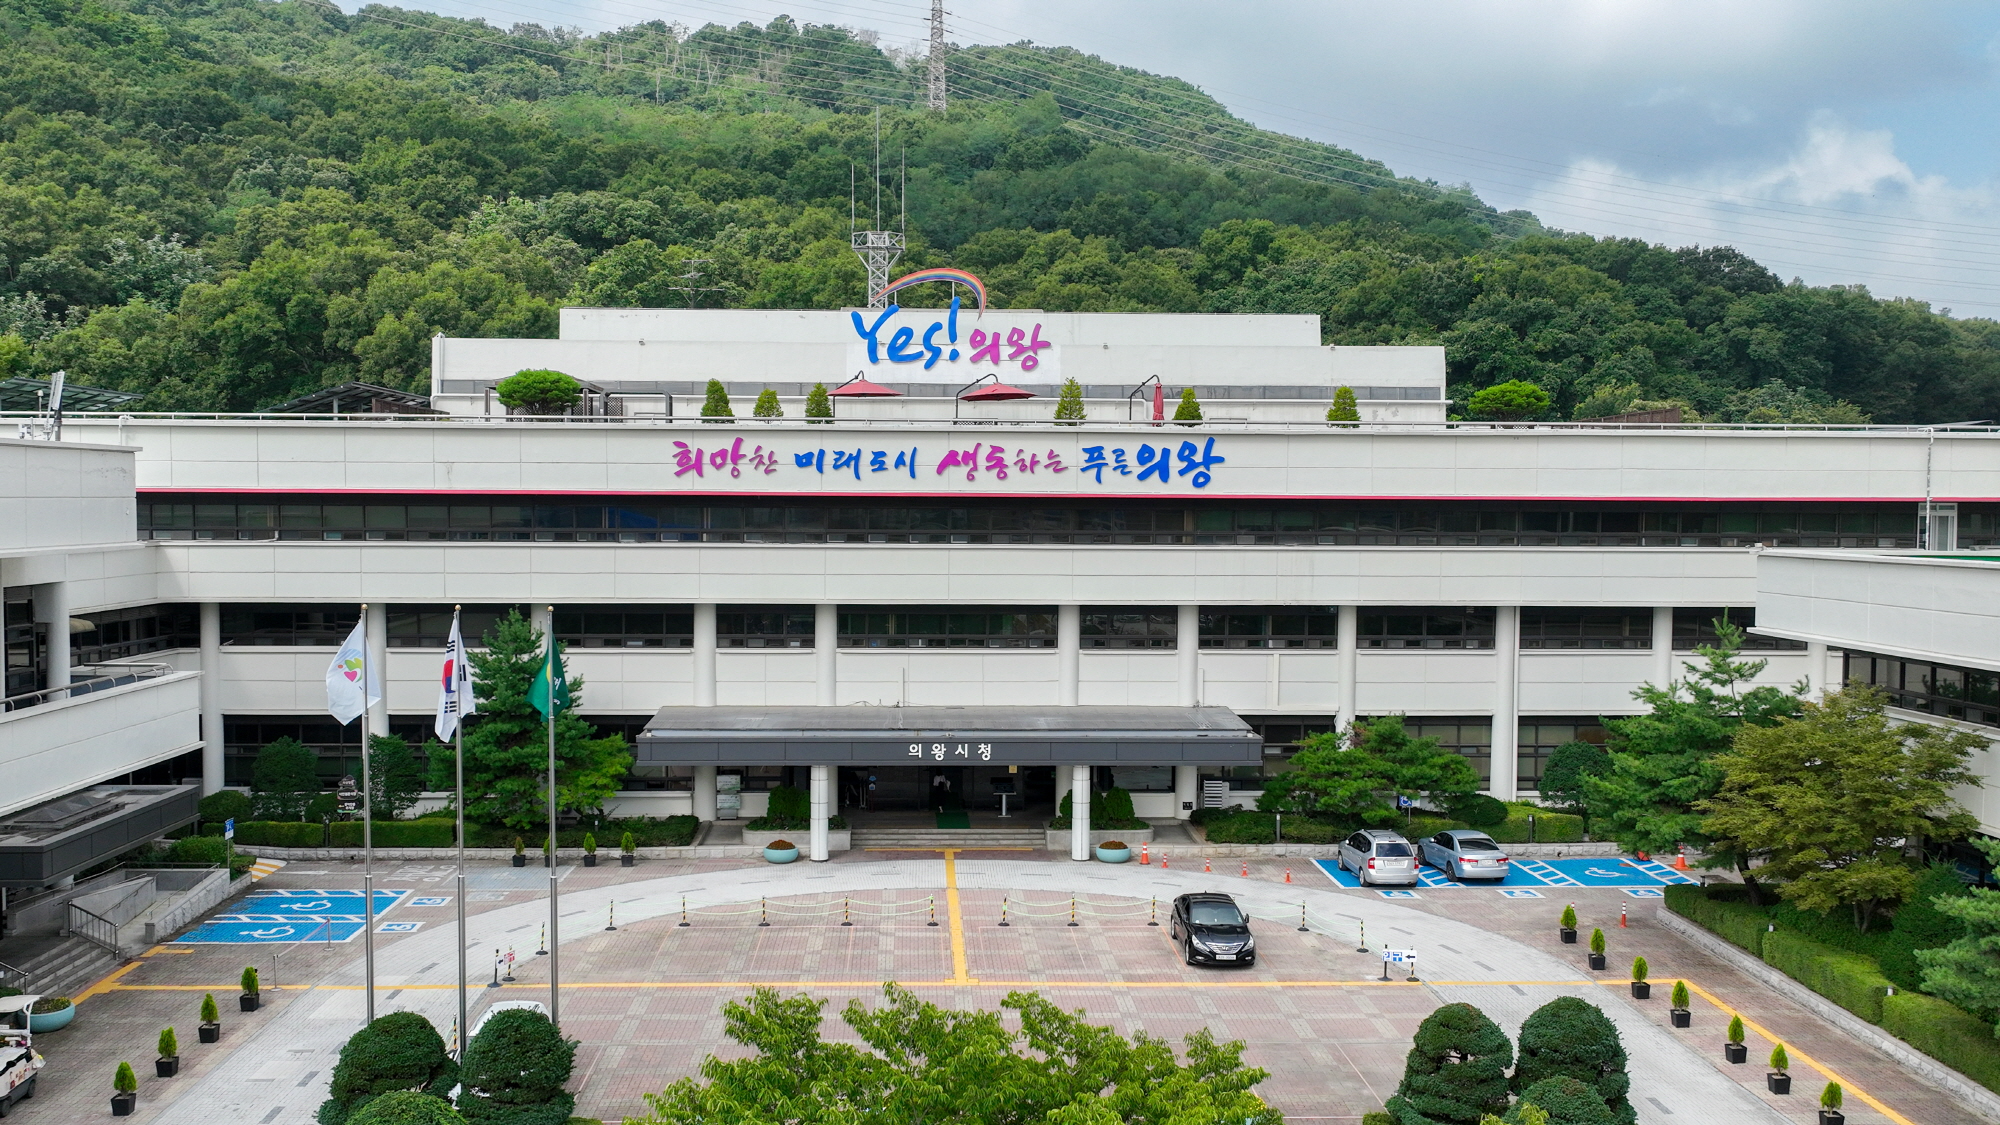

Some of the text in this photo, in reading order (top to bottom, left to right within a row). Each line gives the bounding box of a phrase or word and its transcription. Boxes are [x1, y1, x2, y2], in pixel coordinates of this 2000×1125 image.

[851, 296, 1051, 371] Yes! 의왕
[672, 437, 778, 478] 희망찬
[793, 445, 918, 479] 미래도시
[936, 442, 1068, 481] 생동하는
[908, 743, 992, 761] 의왕시청
